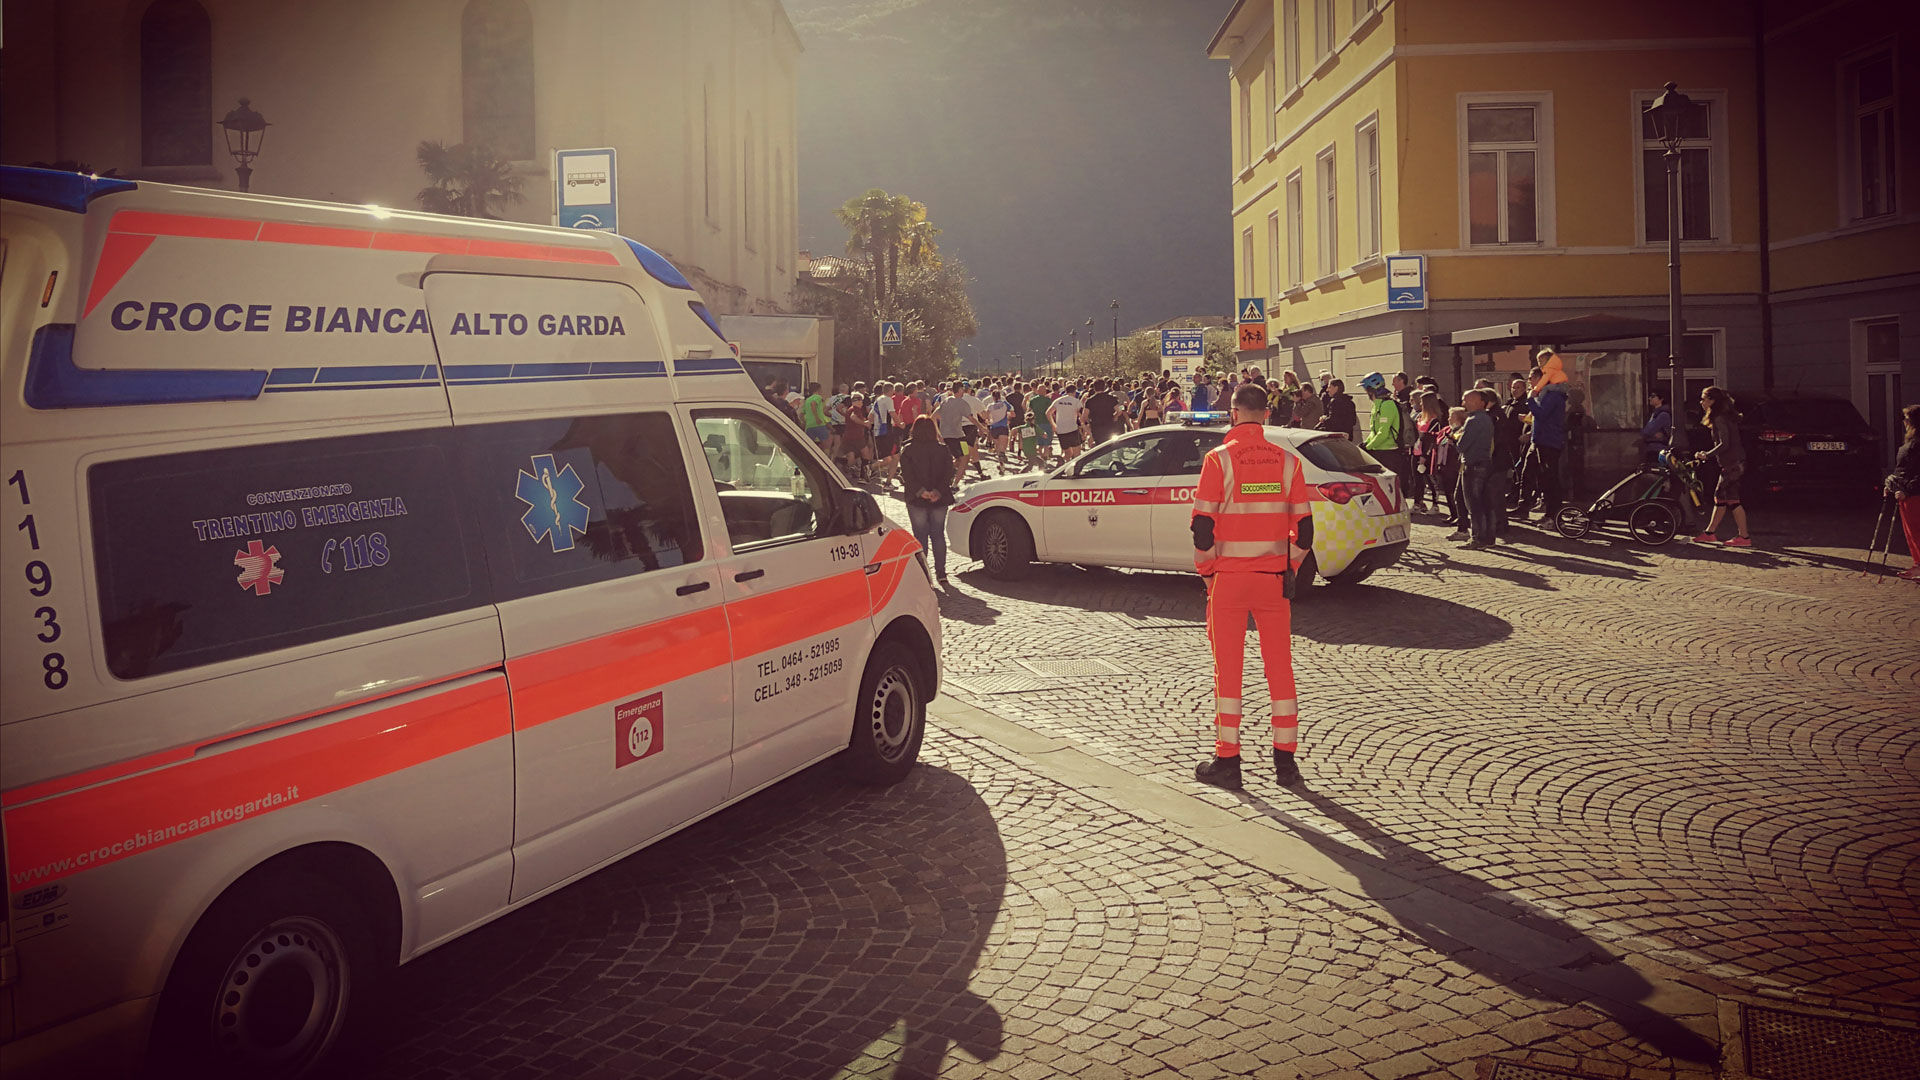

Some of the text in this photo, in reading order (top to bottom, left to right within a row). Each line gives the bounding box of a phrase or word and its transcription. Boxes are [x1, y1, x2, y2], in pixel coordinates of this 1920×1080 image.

[110, 300, 626, 336] CROCE BIANCA ALTO GARDA
[1188, 341, 1200, 349] 84
[247, 483, 352, 505] CONVENZIONATO
[1061, 488, 1197, 504] POLIZIA LOC
[193, 496, 408, 541] TRENTINO EMERGENZA
[340, 532, 390, 571] 118
[830, 543, 860, 561] 119-38
[757, 660, 779, 678] TEL.
[781, 650, 803, 670] 0464
[810, 637, 840, 659] 521995
[754, 682, 783, 702] CELL.
[785, 673, 801, 691] 348
[809, 658, 843, 682] 5215059
[617, 698, 661, 720] Emergenza
[636, 728, 649, 744] 112
[12, 784, 300, 884] www.crocebiancaaltogarda.it
